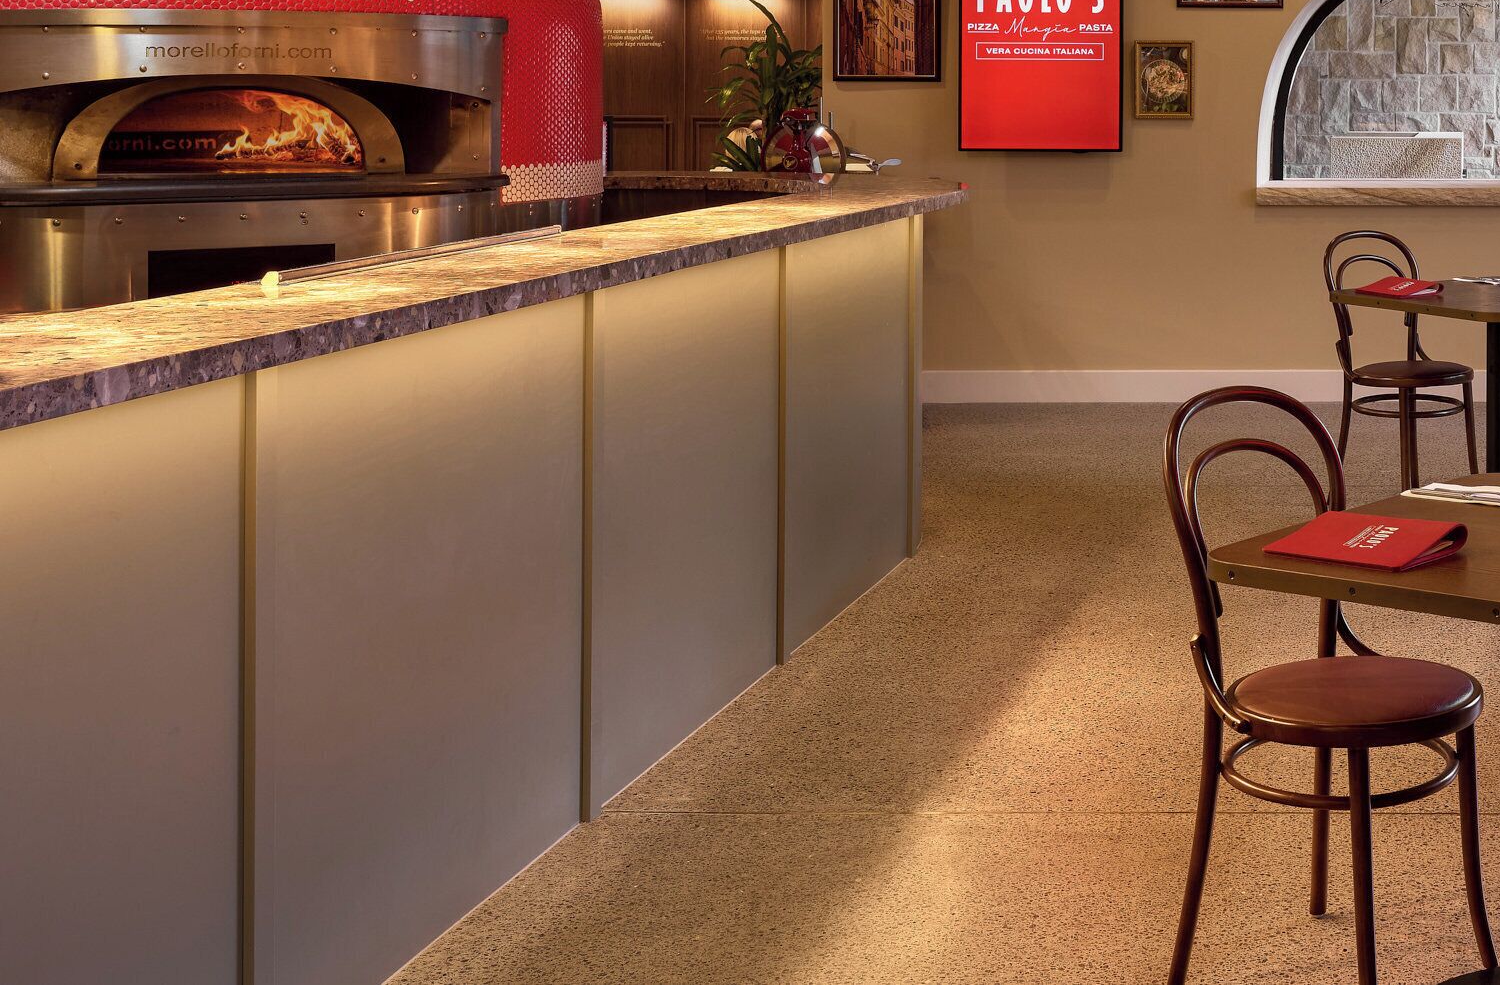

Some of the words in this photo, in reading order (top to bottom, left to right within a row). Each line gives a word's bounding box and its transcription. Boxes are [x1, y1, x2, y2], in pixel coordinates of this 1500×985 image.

[967, 23, 999, 31] PIZZA
[1004, 15, 1077, 42] Mangia
[1079, 23, 1114, 32] PASTA
[145, 42, 332, 59] morelloforni.com
[1358, 526, 1399, 549] PAOLO'S
